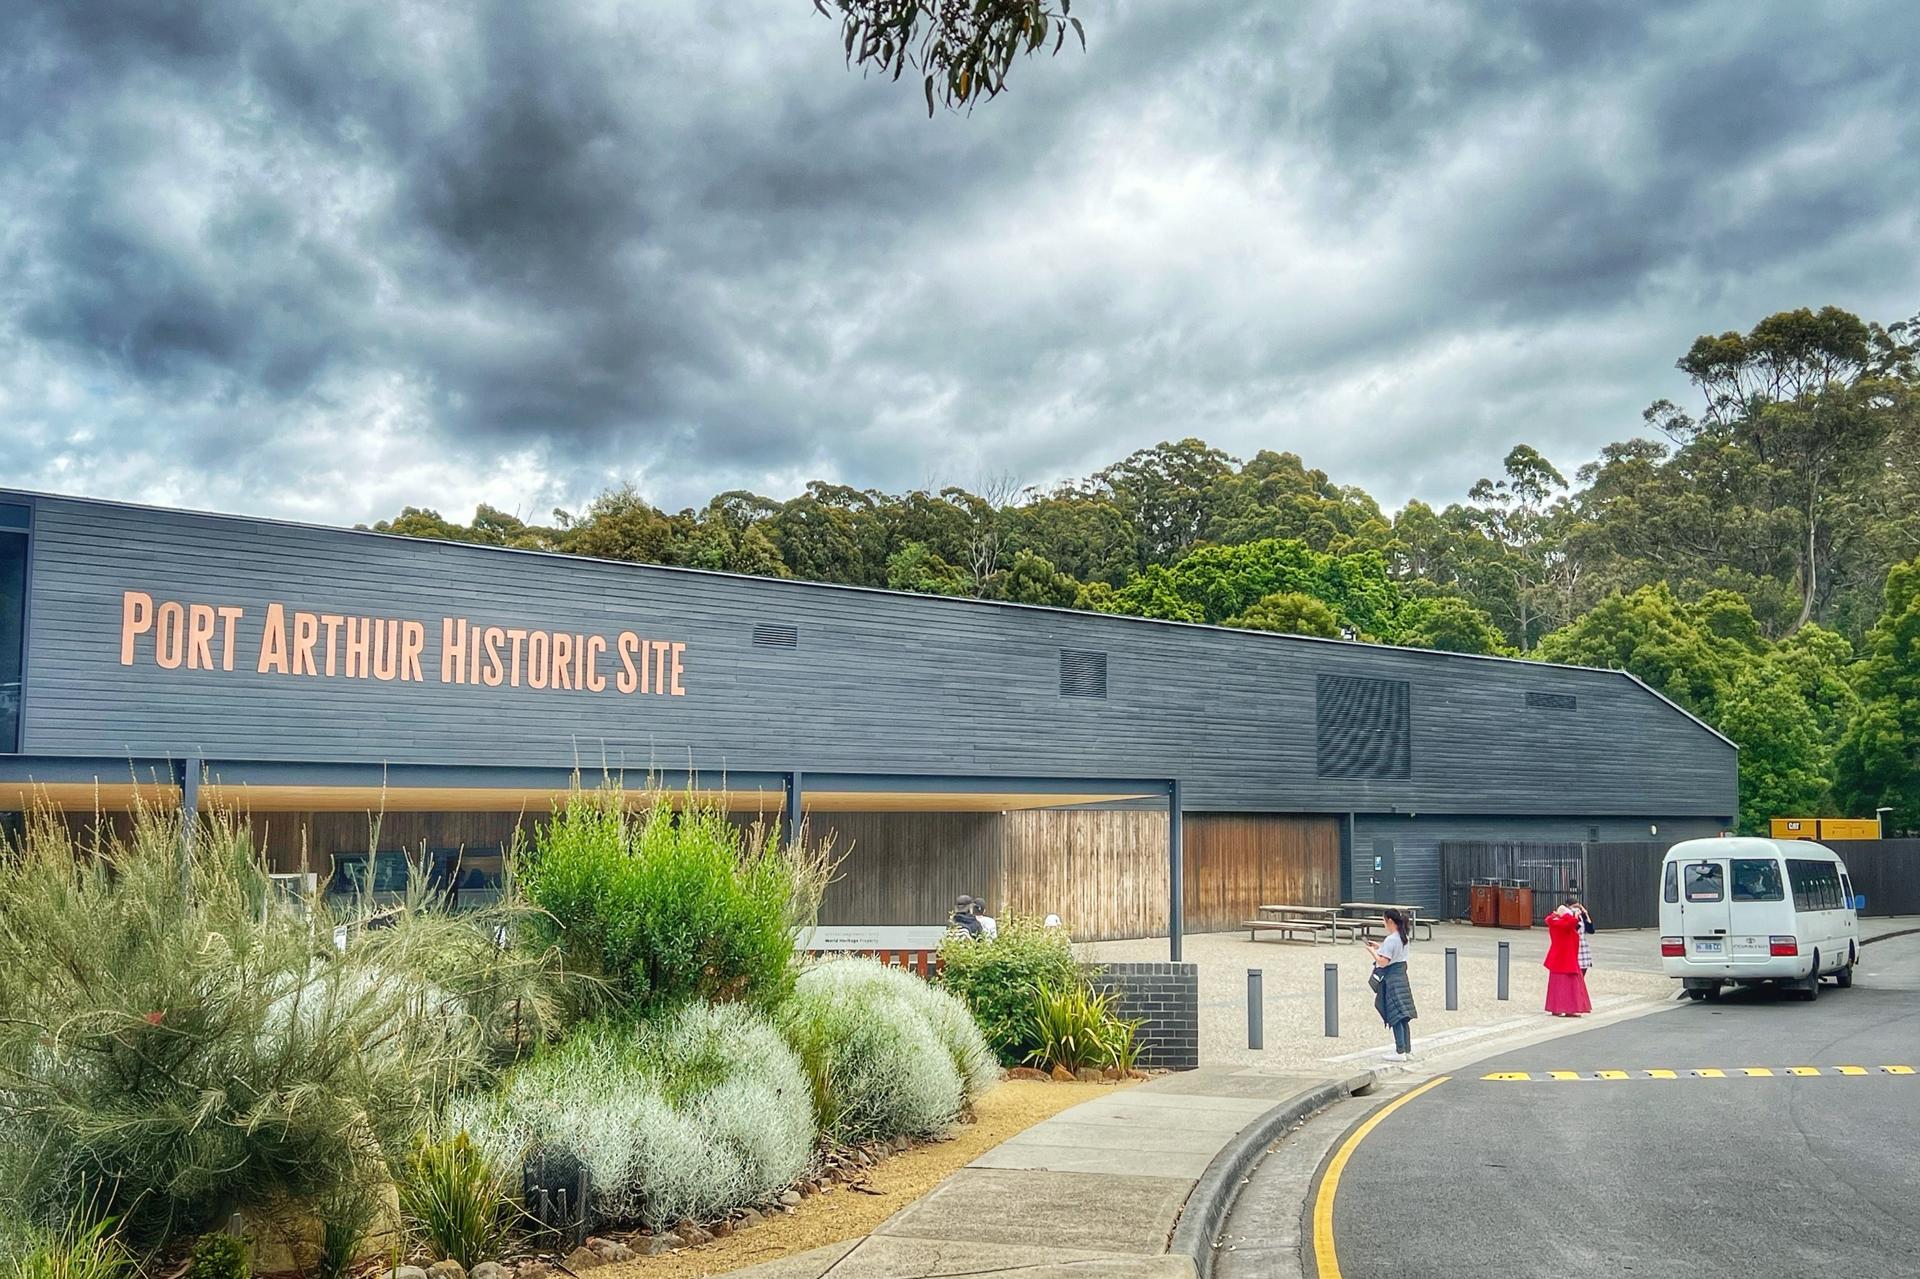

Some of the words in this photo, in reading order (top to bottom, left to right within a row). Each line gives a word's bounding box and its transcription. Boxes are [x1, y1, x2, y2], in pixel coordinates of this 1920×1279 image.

[121, 591, 243, 671] PORT
[258, 603, 425, 681] ARTHUR
[442, 618, 607, 692] HISTORIC
[616, 631, 686, 697] SITE
[1788, 822, 1800, 830] CAT
